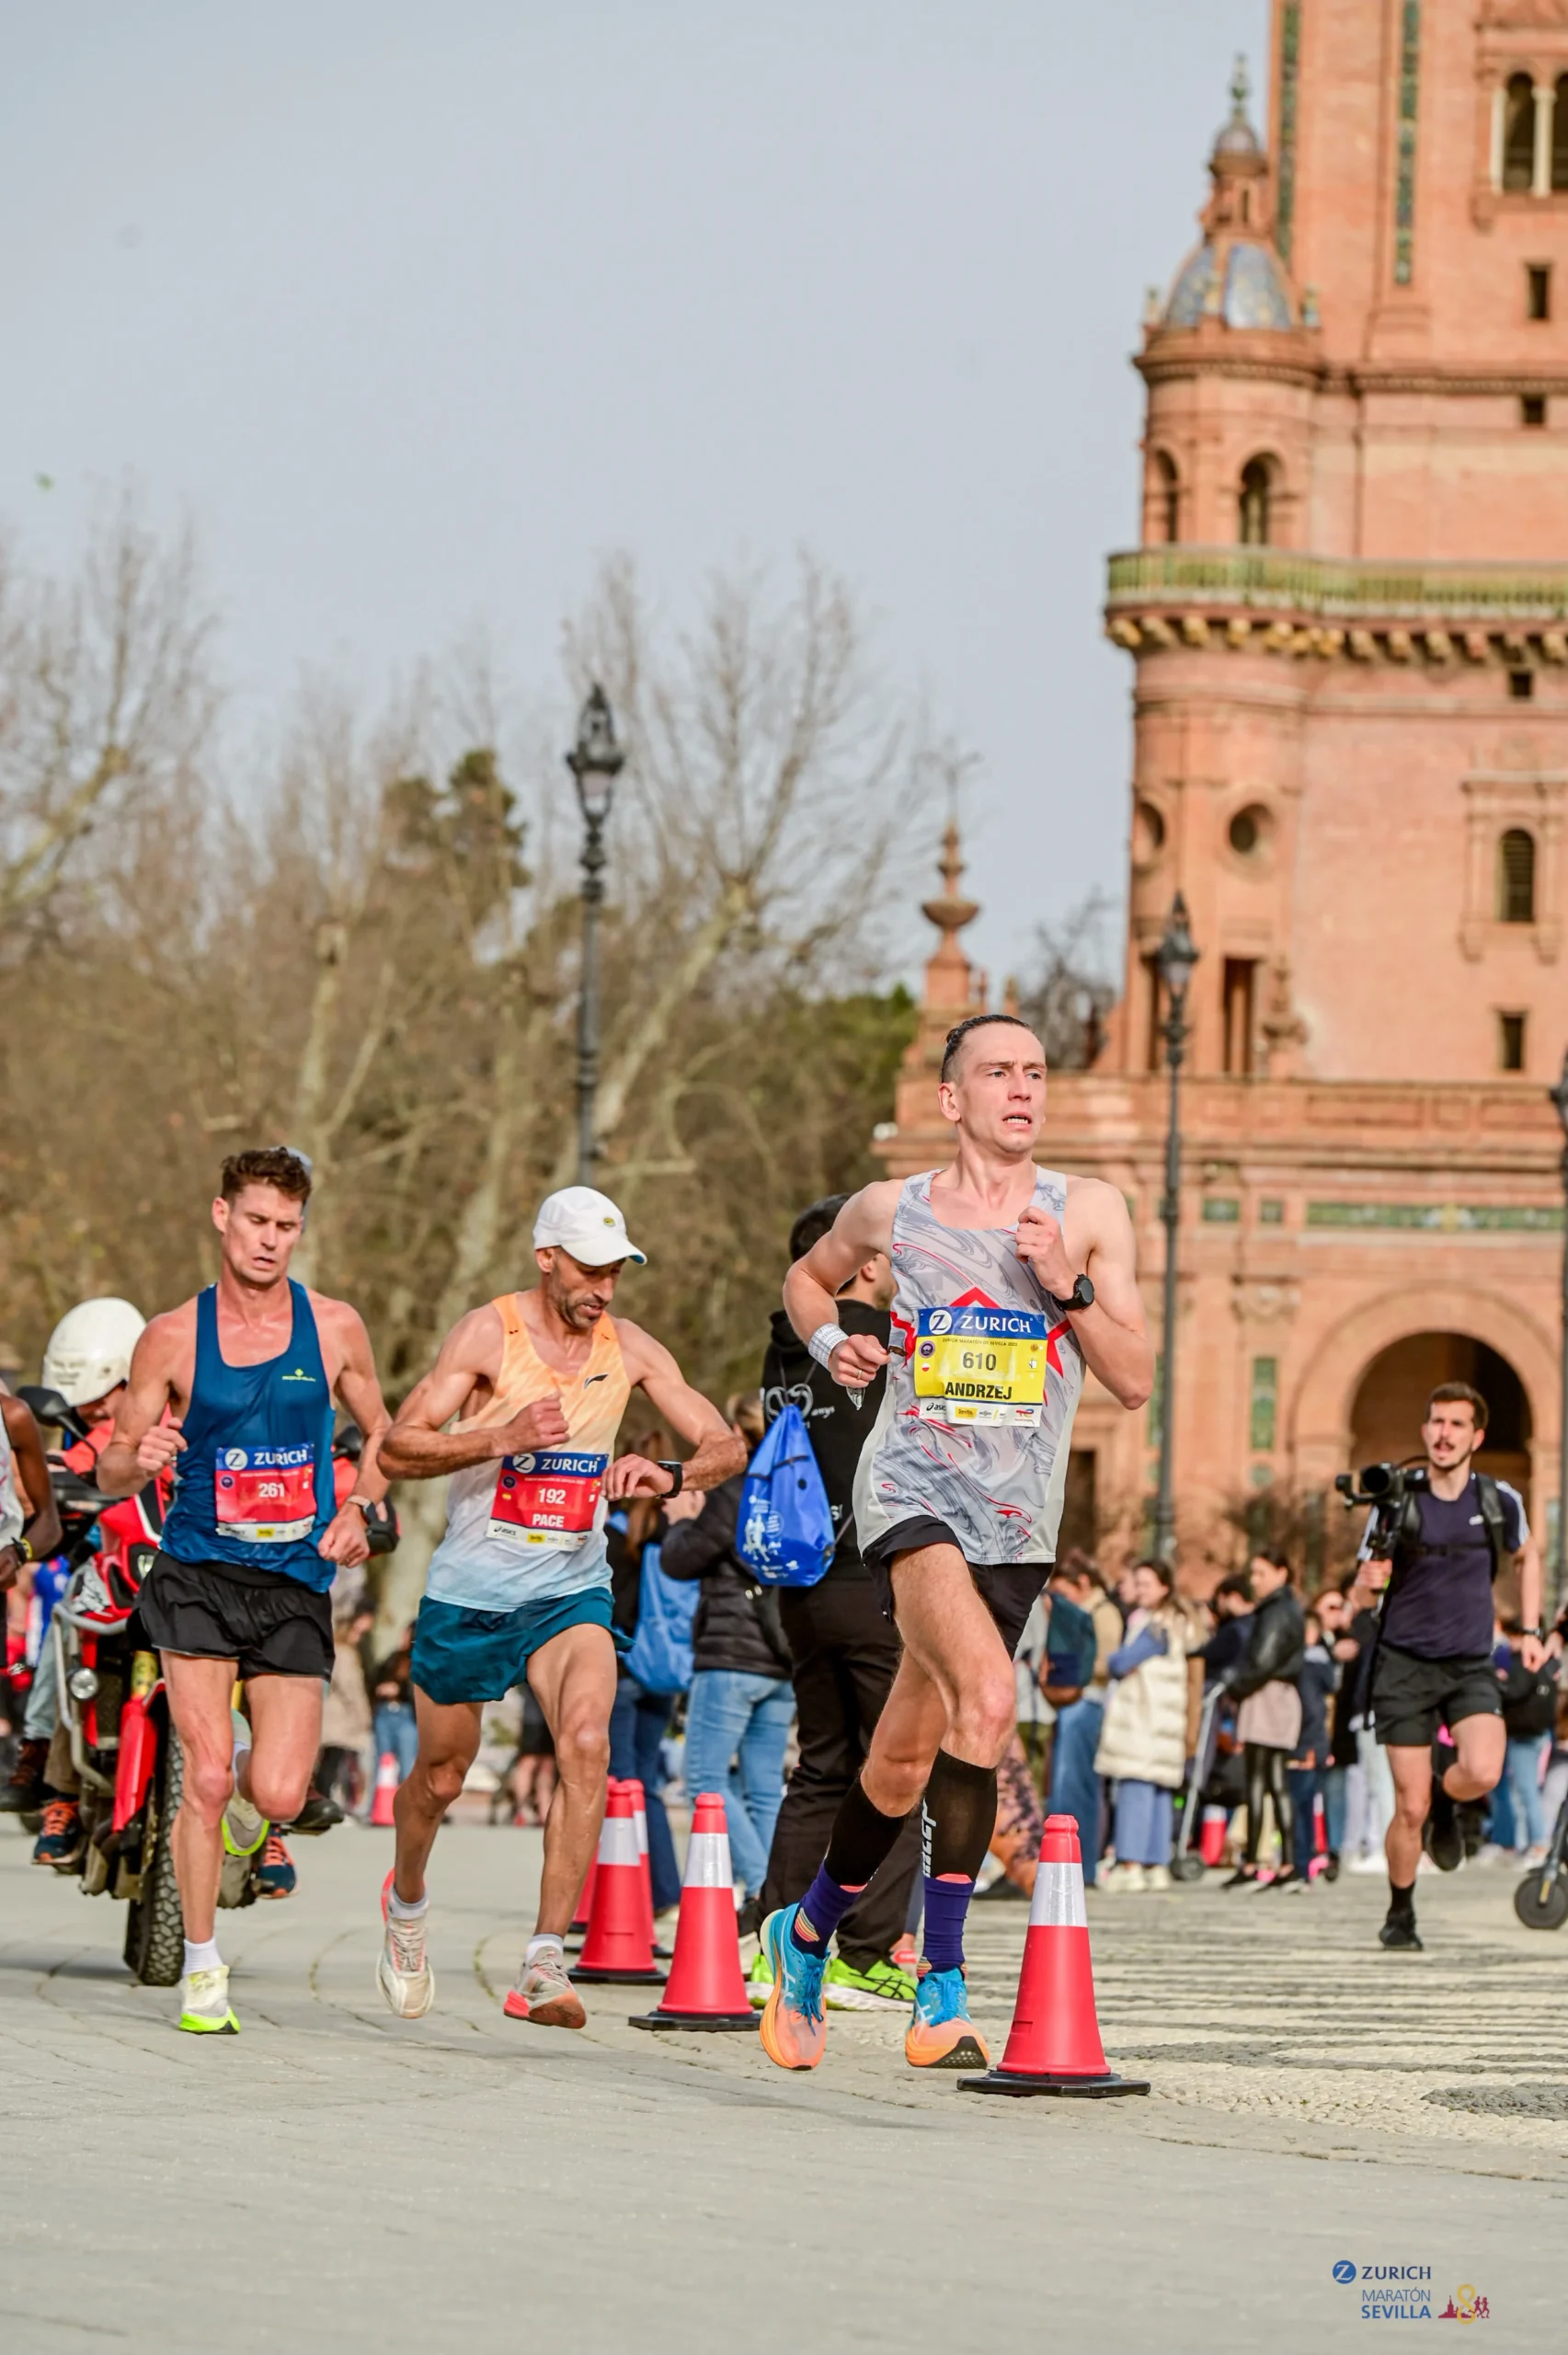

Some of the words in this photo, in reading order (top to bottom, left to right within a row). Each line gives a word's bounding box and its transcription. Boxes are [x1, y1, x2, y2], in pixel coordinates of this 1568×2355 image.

[960, 1315, 1032, 1334] ZURICH
[962, 1351, 997, 1371] 610
[945, 1382, 1013, 1400] ANDRZEJ
[254, 1449, 307, 1465] ZURICH
[541, 1457, 599, 1473] ZURICH
[258, 1482, 285, 1499] 261
[539, 1488, 567, 1505] 192
[532, 1513, 565, 1528] PACE
